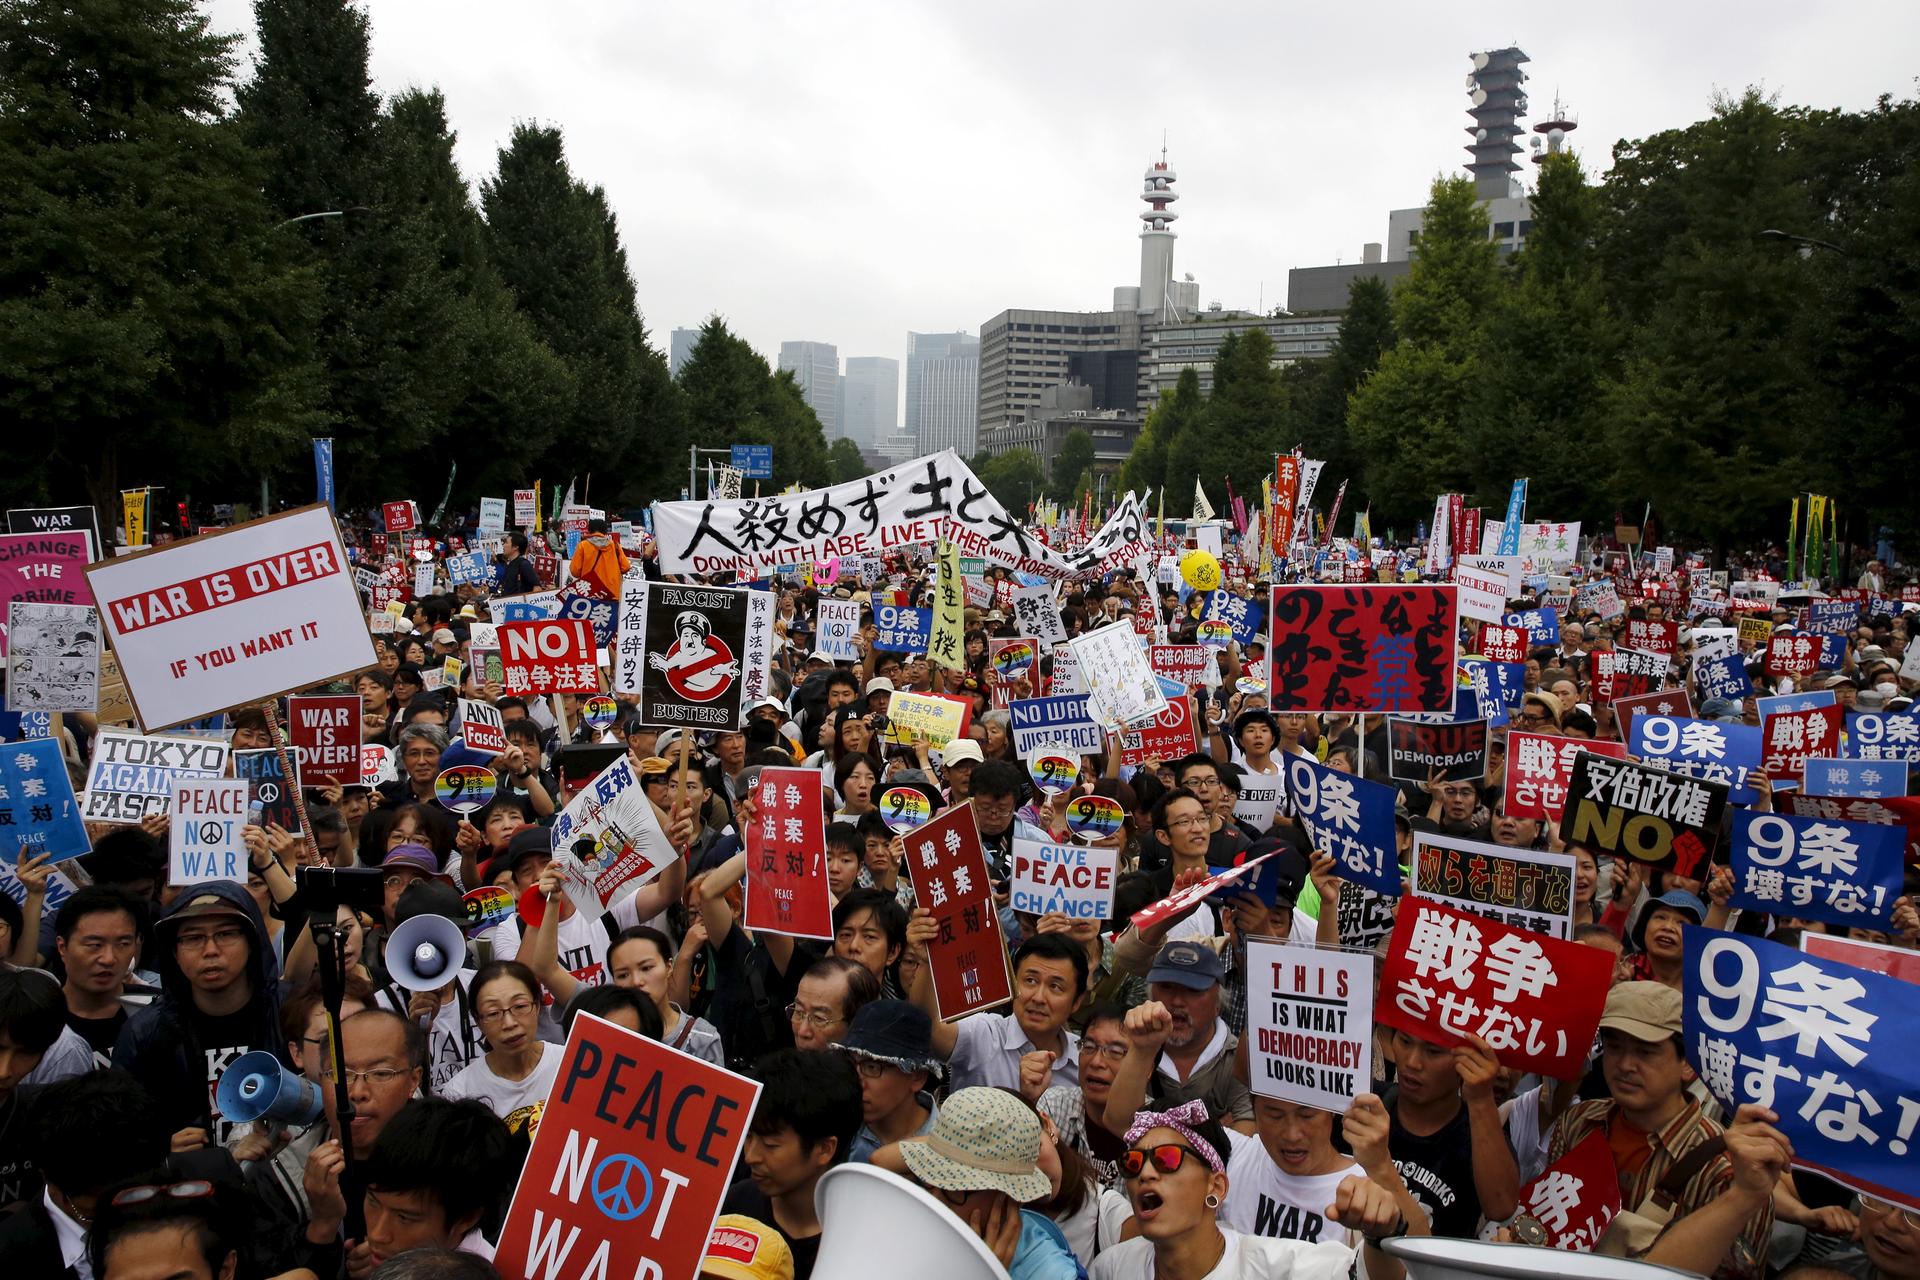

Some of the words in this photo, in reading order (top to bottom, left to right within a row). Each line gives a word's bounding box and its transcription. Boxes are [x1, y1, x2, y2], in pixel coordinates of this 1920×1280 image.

[32, 515, 72, 528] WAR
[391, 517, 407, 525] OVER
[693, 554, 754, 573] DOWN
[759, 543, 817, 567] WITH
[823, 531, 876, 560] ABE.
[880, 521, 926, 548] LIVE
[990, 546, 1016, 566] WITH
[1014, 557, 1069, 580] KOREAN
[18, 563, 63, 580] THE
[449, 556, 476, 572] 9条
[1476, 561, 1505, 569] WAR
[114, 585, 194, 631] WAR
[199, 574, 236, 607] IS
[245, 547, 335, 593] OVER
[1459, 575, 1477, 589] WAR
[1478, 581, 1485, 590] IS
[1486, 582, 1505, 596] OVER
[662, 589, 735, 609] FASCIST
[1213, 588, 1248, 621] 9条
[567, 599, 612, 627] 9条
[820, 604, 857, 621] PEACE
[879, 606, 920, 631] 9条
[1507, 611, 1544, 629] 9条
[506, 621, 588, 660] NO!
[823, 623, 851, 638] NOT
[1485, 627, 1520, 647] 戦争
[1629, 620, 1667, 639] 戦争
[170, 660, 188, 680] IF
[195, 646, 236, 671] YOU
[244, 629, 294, 659] WANT
[300, 621, 320, 640] IT
[1054, 649, 1069, 657] No
[1483, 647, 1523, 660] させない
[1628, 637, 1673, 650] させない
[1772, 637, 1813, 659] 戦争
[1054, 658, 1078, 666] Peace
[1614, 652, 1667, 678] 戦争法案
[1698, 662, 1731, 688] 9条
[1769, 659, 1815, 671] させない
[505, 662, 598, 693] 戦争法案
[300, 708, 349, 728] WAR
[467, 703, 500, 728] ANTI
[653, 703, 729, 723] BUSTERS
[898, 699, 944, 718] 憲法9条
[1013, 704, 1042, 725] NO
[1046, 699, 1089, 721] WAR
[316, 728, 336, 746] IS
[468, 727, 507, 749] Fascis
[1053, 724, 1098, 748] PEACE
[1144, 733, 1192, 747] するために
[1391, 721, 1484, 754] TRUE
[1642, 716, 1727, 759] 9条
[1770, 711, 1828, 751] 戦争
[1855, 714, 1920, 744] 9条
[102, 737, 224, 771] TOKYO
[299, 745, 357, 765] OVER!
[1393, 749, 1483, 768] DEMOCRACY
[595, 760, 633, 807] 反対
[1041, 759, 1056, 783] 9
[1827, 768, 1883, 786] 戦争
[445, 771, 466, 800] 9
[761, 782, 803, 810] 戦争
[1251, 790, 1275, 801] OVER
[1290, 759, 1361, 833] 9条
[1584, 761, 1712, 829] 安倍政権
[86, 791, 172, 820] FASCI
[179, 788, 243, 815] PEACE
[889, 792, 905, 819] 9
[1078, 800, 1097, 826] 9
[16, 832, 46, 844] PEACE
[185, 820, 233, 846] NOT
[762, 815, 804, 844] 法案
[1572, 799, 1674, 862] NO
[919, 828, 962, 870] 戦争
[1040, 845, 1088, 866] GIVE
[1747, 815, 1860, 876] 9条
[182, 851, 237, 878] WAR
[1015, 856, 1111, 890] PEACE
[928, 865, 973, 908] 法案
[1418, 843, 1571, 914] 奴らを通すな
[1744, 866, 1887, 916] 壊すな!
[774, 888, 793, 900] PEACE
[1014, 891, 1108, 918] CHANCE
[1055, 887, 1065, 899] A
[1405, 907, 1558, 1003] 戦争
[961, 968, 980, 987] NOT
[1271, 962, 1349, 998] THIS
[965, 987, 983, 1005] WAR
[1697, 936, 1880, 1068] 9条
[1272, 1001, 1289, 1026] IS
[1296, 1005, 1347, 1034] WHAT
[1395, 978, 1568, 1057] させない
[1258, 1027, 1362, 1070] DEMOCRACY
[1266, 1058, 1316, 1090] LOOKS
[1321, 1071, 1353, 1098] LIKE
[561, 1039, 740, 1168] PEACE
[549, 1127, 690, 1241] NOT
[1412, 1165, 1456, 1207] WORKS
[1254, 1193, 1325, 1244] WAR
